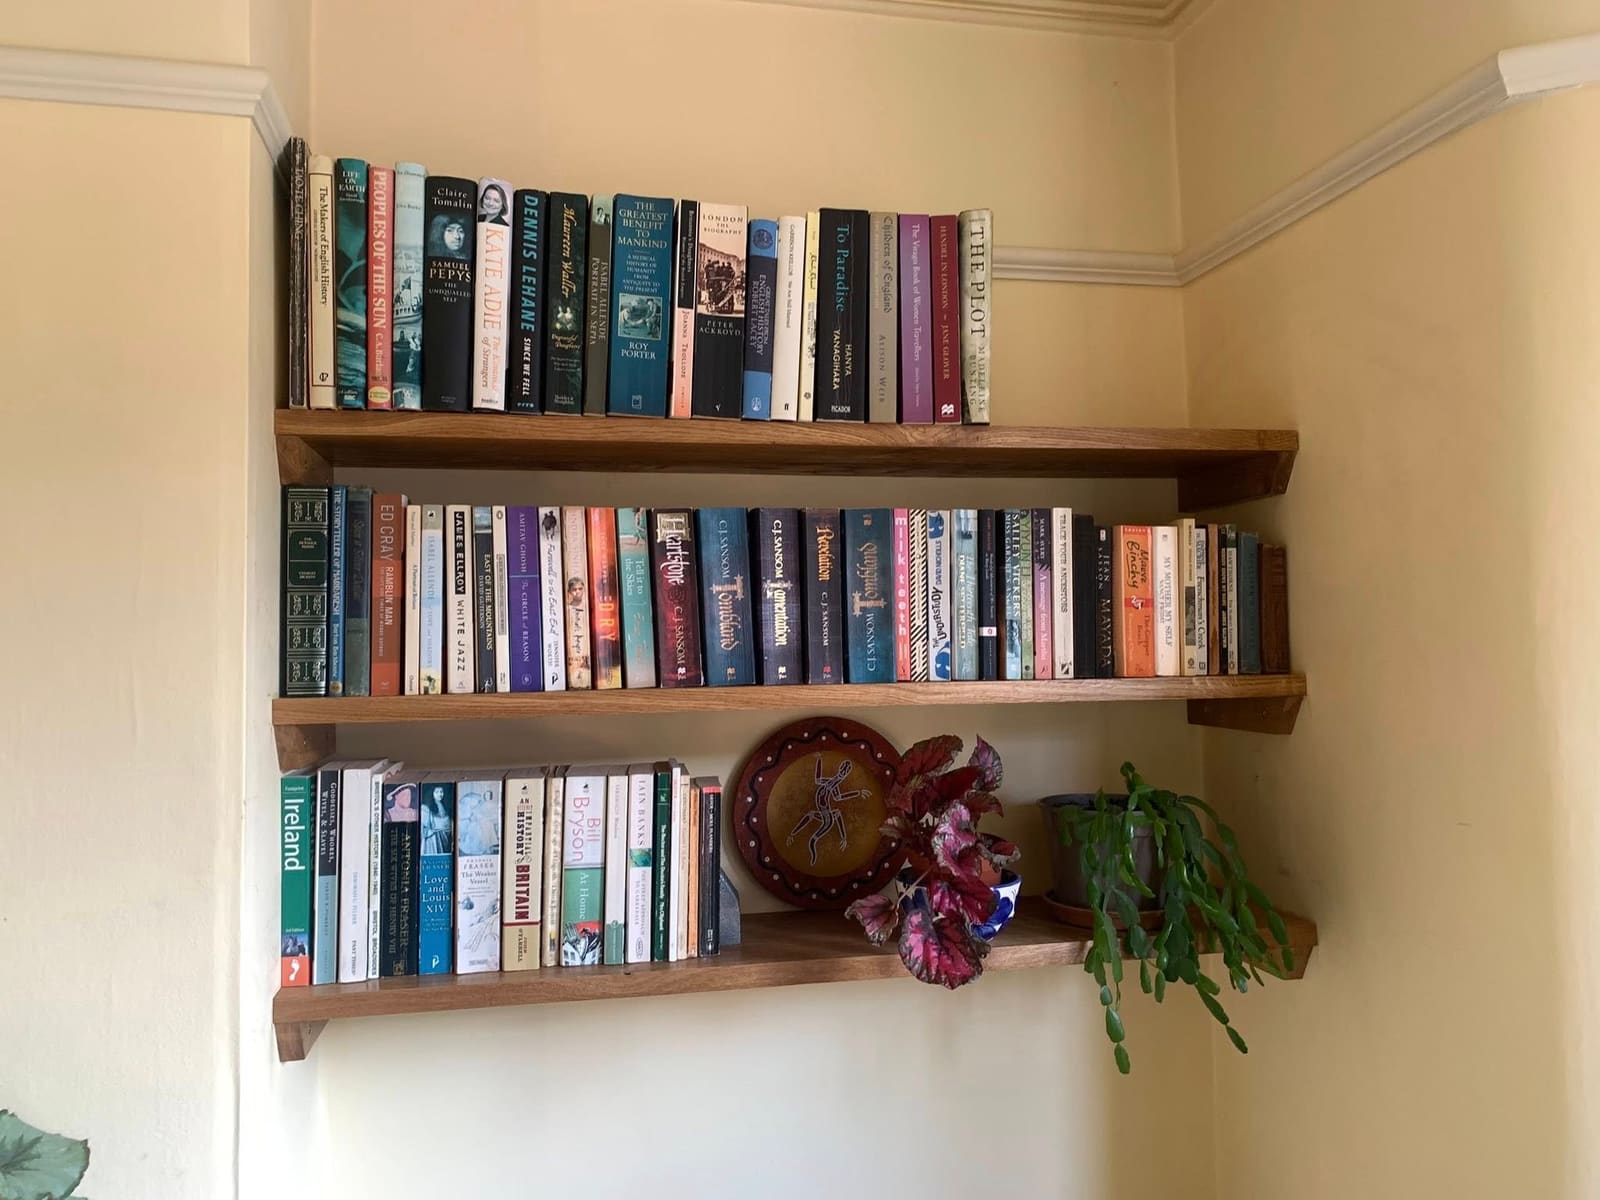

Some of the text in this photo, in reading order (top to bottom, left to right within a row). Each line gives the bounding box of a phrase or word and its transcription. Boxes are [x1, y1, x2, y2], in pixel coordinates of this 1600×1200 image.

[339, 185, 366, 193] EARTH
[342, 170, 361, 178] LIFE
[345, 177, 356, 187] ON
[436, 188, 468, 199] Claire
[432, 197, 473, 210] Tomalin
[619, 209, 668, 222] GREATEST
[623, 218, 664, 231] BENEFIT
[634, 202, 656, 211] THE
[703, 213, 744, 224] LONDON
[319, 187, 330, 306] The Makers of English History
[373, 170, 388, 330] PEOPLES OF THE SUN
[561, 203, 577, 299] Maureen Waller
[618, 236, 669, 249] MANKIND
[635, 229, 651, 238] TO
[704, 227, 743, 236] BIOGRAPHY
[911, 223, 921, 240] The
[970, 226, 984, 273] THE
[429, 269, 472, 284] PEPYS
[432, 261, 470, 271] SAMUEL
[483, 228, 504, 331] KATE ADIE
[520, 195, 539, 332] DENNIS LEHANE
[626, 266, 657, 275] HUMANITY
[834, 224, 850, 312] To Paradise
[879, 215, 894, 313] Children of England
[911, 266, 921, 285] Book
[589, 257, 601, 346] PORTRAIT SEPIA
[598, 262, 609, 341] ISABEL ALLENDE
[707, 319, 734, 329] PETER
[749, 281, 760, 348] ROBERT LACEY
[756, 274, 767, 355] ENGLISH HISTORY
[912, 295, 922, 325] Women
[939, 225, 951, 380] HANDEL LONDON JANE GLOVER
[970, 280, 986, 338] PLOT
[523, 337, 532, 362] SINCE
[620, 348, 656, 360] PORTER
[629, 341, 649, 350] ROY
[699, 327, 741, 336] ACKROYD
[913, 326, 922, 361] Travellers
[480, 347, 491, 388] Strangers
[522, 363, 531, 377] WE
[832, 329, 842, 390] YANAGIHARA
[843, 343, 853, 377] HANYA
[878, 335, 888, 404] ALISON WEIR
[967, 355, 977, 406] BUNTING
[978, 345, 987, 413] MADELEINE
[521, 378, 531, 396] FELL
[831, 404, 851, 414] PICADOR
[379, 505, 395, 561] ED CRAY
[895, 517, 908, 565] milk
[1020, 521, 1031, 562] YIYUN
[1059, 514, 1067, 541] TRACE
[332, 490, 342, 616] THE STORYTELLER MARRAKESH
[935, 540, 943, 566] NICHOLLS
[1012, 513, 1021, 617] SALLEY VICKERS
[1126, 541, 1141, 589] Binchy
[1139, 548, 1150, 584] Maeve
[384, 566, 394, 626] RAMBLIN' MAN
[456, 512, 465, 672] JAMES ELLROY WHITE JAZZ
[518, 513, 530, 662] AMITAV GHOSH CIRCLE REASON
[547, 543, 559, 636] Farewell East End
[625, 559, 635, 597] the Skies
[636, 559, 645, 595] Tell to
[657, 513, 690, 664] Heartstone SANSOM
[710, 537, 745, 651] SANSOM Tombland
[762, 536, 793, 647] SANSOM Lamentation
[816, 522, 836, 647] Revelation SANSOM
[853, 542, 888, 655] SANSOM Tombland
[1060, 566, 1068, 614] ANCESTORS
[483, 554, 494, 651] EAST OF THE MOUNTAINS
[599, 603, 616, 642] DRY
[898, 574, 908, 636] teeth
[931, 586, 947, 641] UNDERSTUDY
[1164, 557, 1173, 648] MY MOTHER MY SELF
[1196, 575, 1206, 626] Frenchman's
[1101, 598, 1112, 668] MAYADA
[1197, 626, 1206, 650] Creek
[284, 798, 306, 871] Ireland
[516, 812, 526, 856] HISTORY
[524, 810, 533, 856] IMPARTIAL
[567, 796, 590, 863] Bryson
[587, 817, 601, 843] Bill
[637, 779, 647, 847] IAIN BANKS
[424, 875, 449, 884] Love
[427, 883, 445, 893] and
[461, 870, 497, 879] The Weaker
[463, 862, 494, 870] FRASER
[470, 877, 489, 885] Vessel
[399, 832, 411, 950] ANTONIA FRASER
[422, 892, 451, 902] Louis
[426, 904, 446, 914] XIV
[515, 864, 531, 920] BRITAIN
[579, 871, 590, 920] At Home
